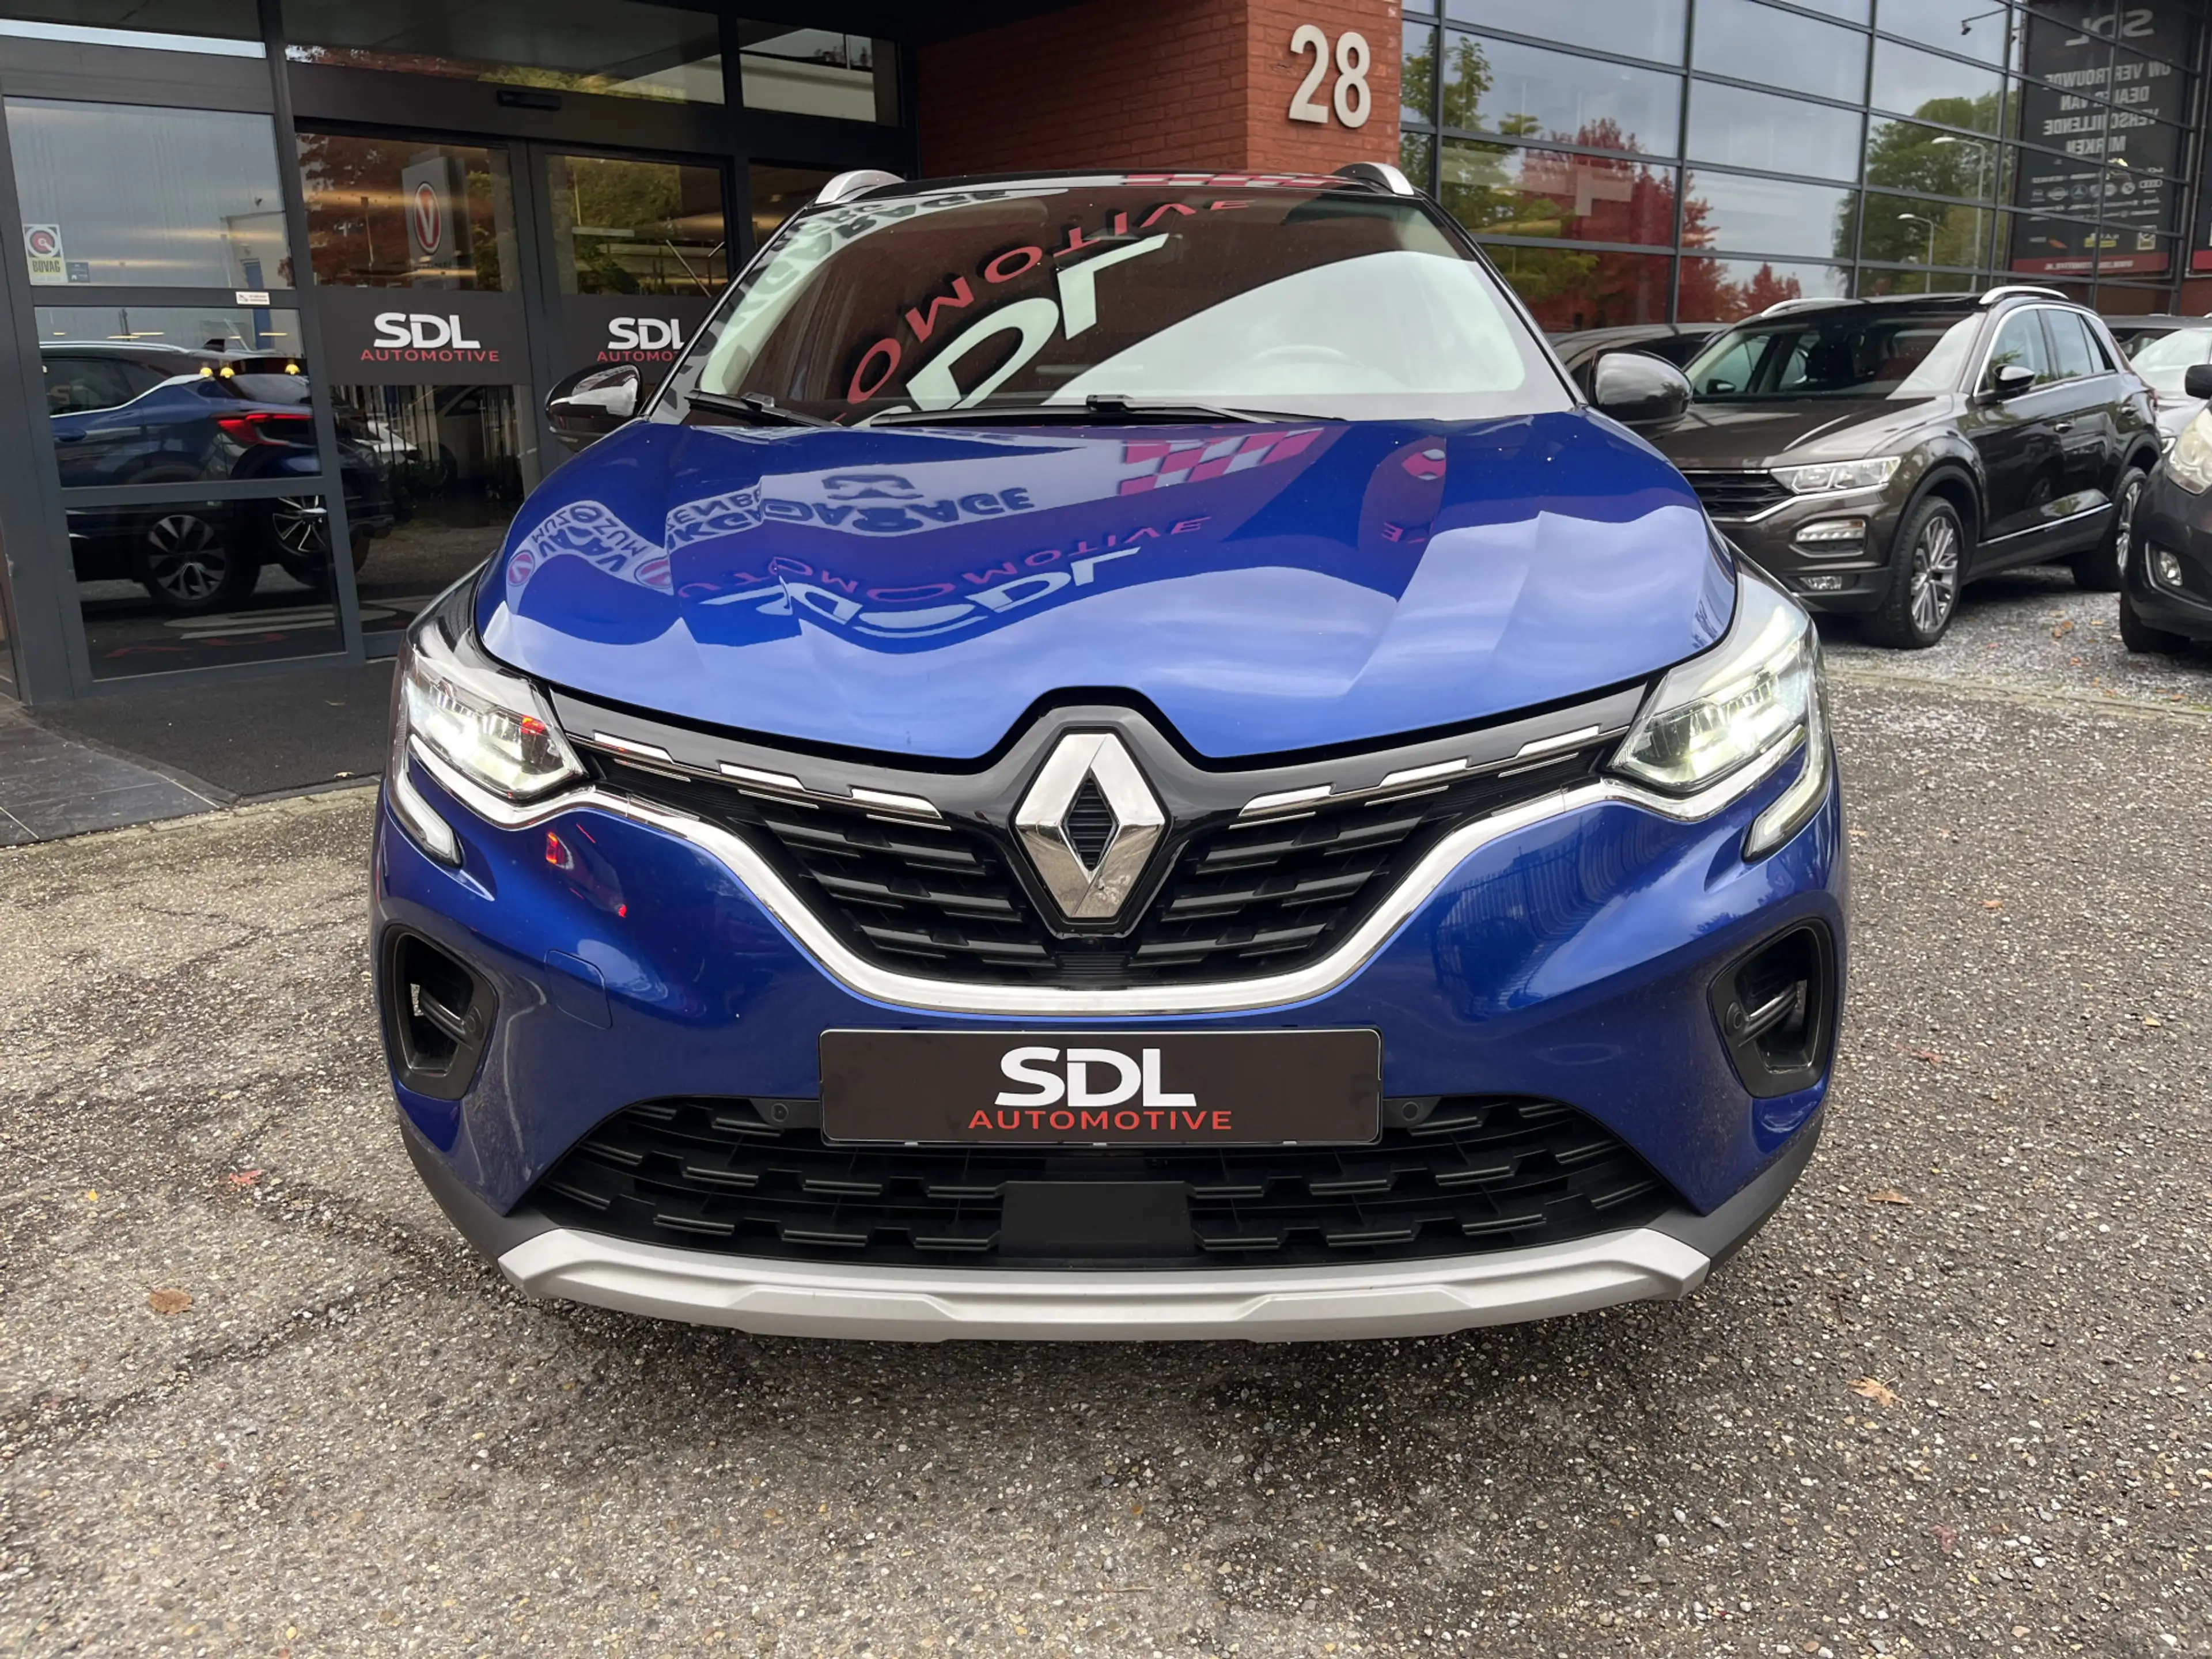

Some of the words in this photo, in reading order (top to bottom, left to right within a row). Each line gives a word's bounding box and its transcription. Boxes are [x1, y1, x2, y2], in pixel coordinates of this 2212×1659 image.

[1289, 24, 1371, 127] 28
[32, 260, 60, 273] BOVAG
[373, 312, 481, 349] SDL
[360, 349, 500, 362] AUTOMOTIVE
[994, 1047, 1197, 1107] SDL
[968, 1110, 1232, 1131] AUTOMOTIVE
